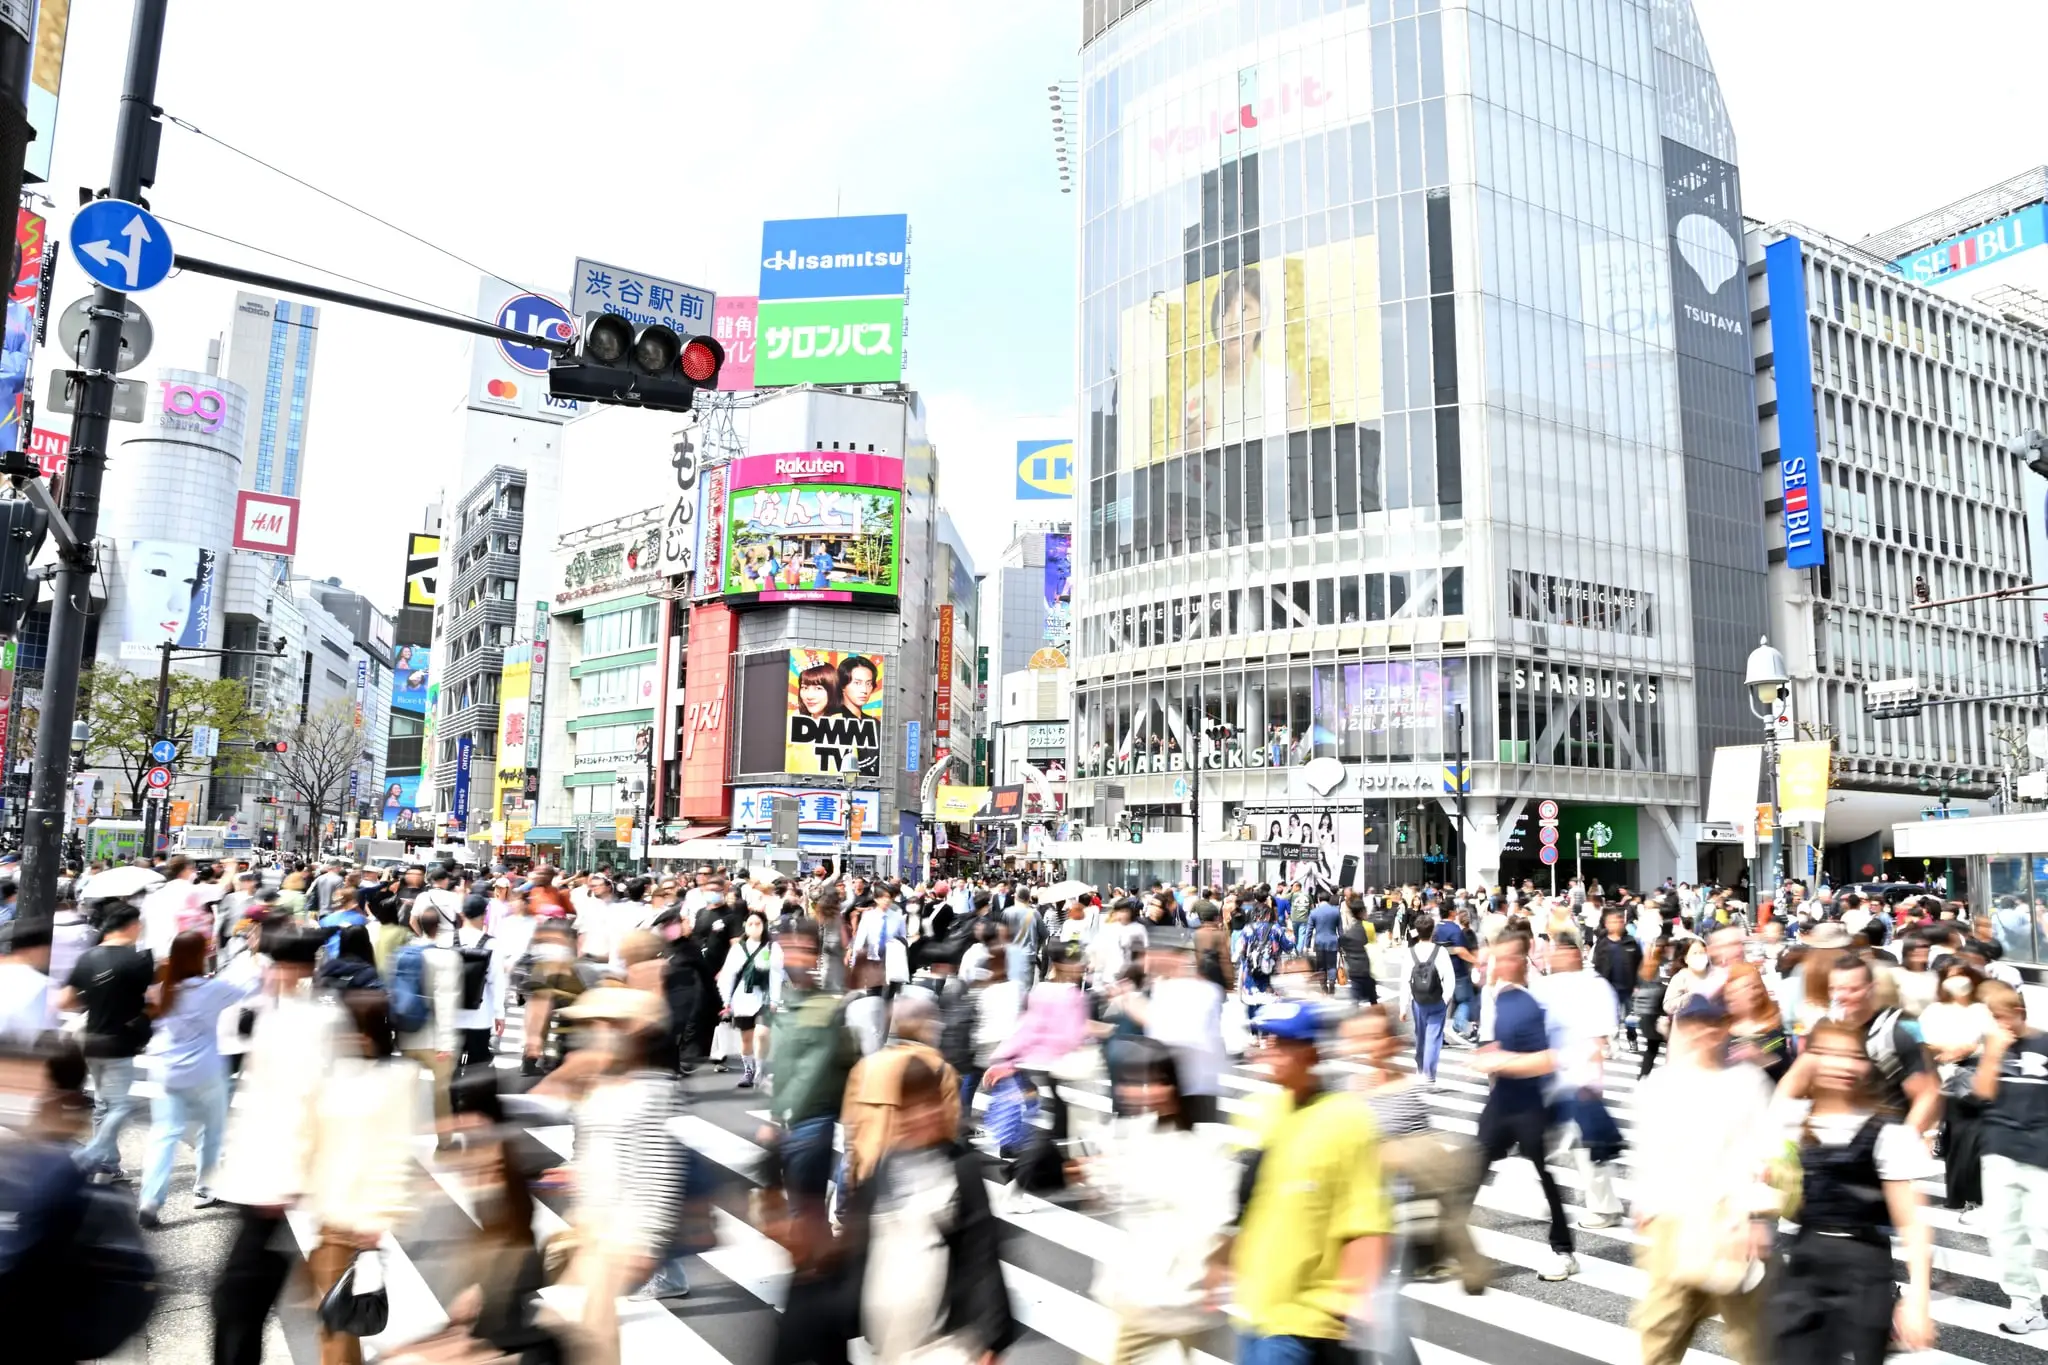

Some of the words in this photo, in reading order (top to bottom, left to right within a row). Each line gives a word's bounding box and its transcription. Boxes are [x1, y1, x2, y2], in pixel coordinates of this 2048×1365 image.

[762, 249, 904, 271] Hisamitsu
[1912, 218, 2025, 282] SEIBU
[585, 269, 705, 321] 渋谷駅前
[239, 305, 270, 317] INDIGO
[1684, 303, 1744, 336] TSUTAYA
[662, 316, 689, 334] Sta.
[717, 315, 758, 340] 龍角
[765, 322, 893, 360] サロンパス
[160, 381, 227, 433] 109
[542, 392, 578, 411] VISA
[775, 457, 845, 476] Rakuten
[665, 431, 697, 569] もんじゃ
[1783, 456, 1811, 550] SEIBU
[250, 512, 284, 533] H&M
[1125, 607, 1165, 626] SAE
[940, 608, 952, 681] クスリのことなら
[1514, 669, 1658, 704] STARBUCKS
[686, 683, 726, 761] クスリ
[791, 716, 878, 748] DMM
[1029, 737, 1065, 746] クリニック
[461, 744, 470, 770] MIZUHO
[814, 746, 853, 773] TV
[1106, 748, 1265, 776] STARBCKS
[1355, 774, 1434, 791] TSUTAYA
